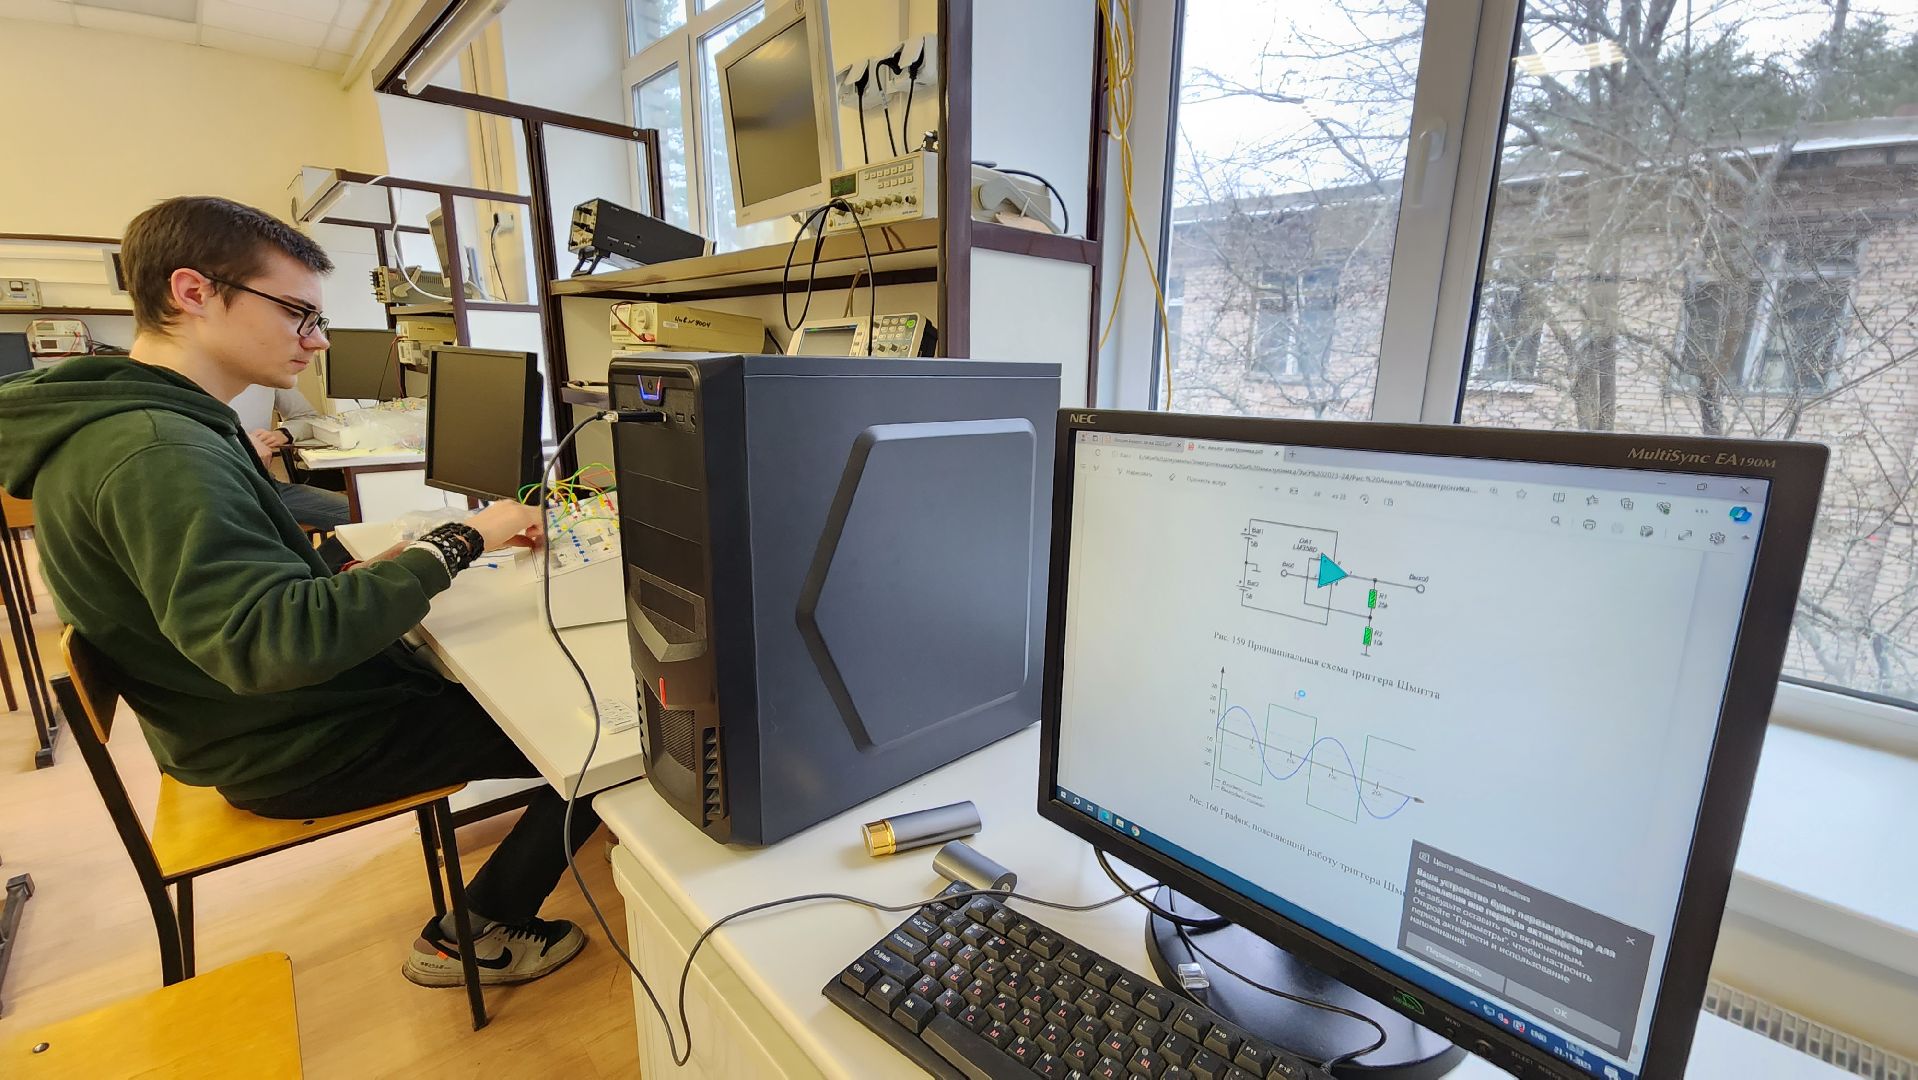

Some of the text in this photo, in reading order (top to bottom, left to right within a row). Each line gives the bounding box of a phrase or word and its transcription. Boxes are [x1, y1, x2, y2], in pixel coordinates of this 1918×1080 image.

[1069, 413, 1099, 424] NEC
[1627, 447, 1776, 468] MultiSync EA190M
[1214, 630, 1229, 642] Рис.
[1231, 635, 1246, 647] 159
[1321, 660, 1348, 675] схема
[1351, 669, 1393, 687] триггера
[1396, 680, 1441, 700] Шмитта
[1188, 793, 1204, 806] Рис.
[1205, 801, 1219, 813] 160
[1220, 808, 1251, 830] График,
[1307, 847, 1339, 868] работу
[1339, 861, 1381, 887] триггера
[1497, 883, 1531, 903] Windows
[1417, 867, 1616, 959] Ваше устройство будет перезагружено для
[1410, 915, 1467, 947] напоминаний.
[1413, 896, 1451, 919] Откройте
[1512, 941, 1541, 960] чтобы
[1542, 954, 1593, 983] настроить
[1414, 887, 1585, 967] Не забудьте оставить его включенным.
[1467, 901, 1485, 913] вне
[1485, 907, 1525, 931] периода
[1527, 926, 1583, 956] активности
[1411, 906, 1441, 925] период
[1441, 921, 1489, 947] активности
[1499, 947, 1570, 985] использование
[1215, 1029, 1227, 1039] F10
[1445, 1016, 1461, 1027] MENU
[1530, 1028, 1548, 1043] ENG
[1245, 1046, 1257, 1056] F11
[1511, 1050, 1534, 1065] SELECT
